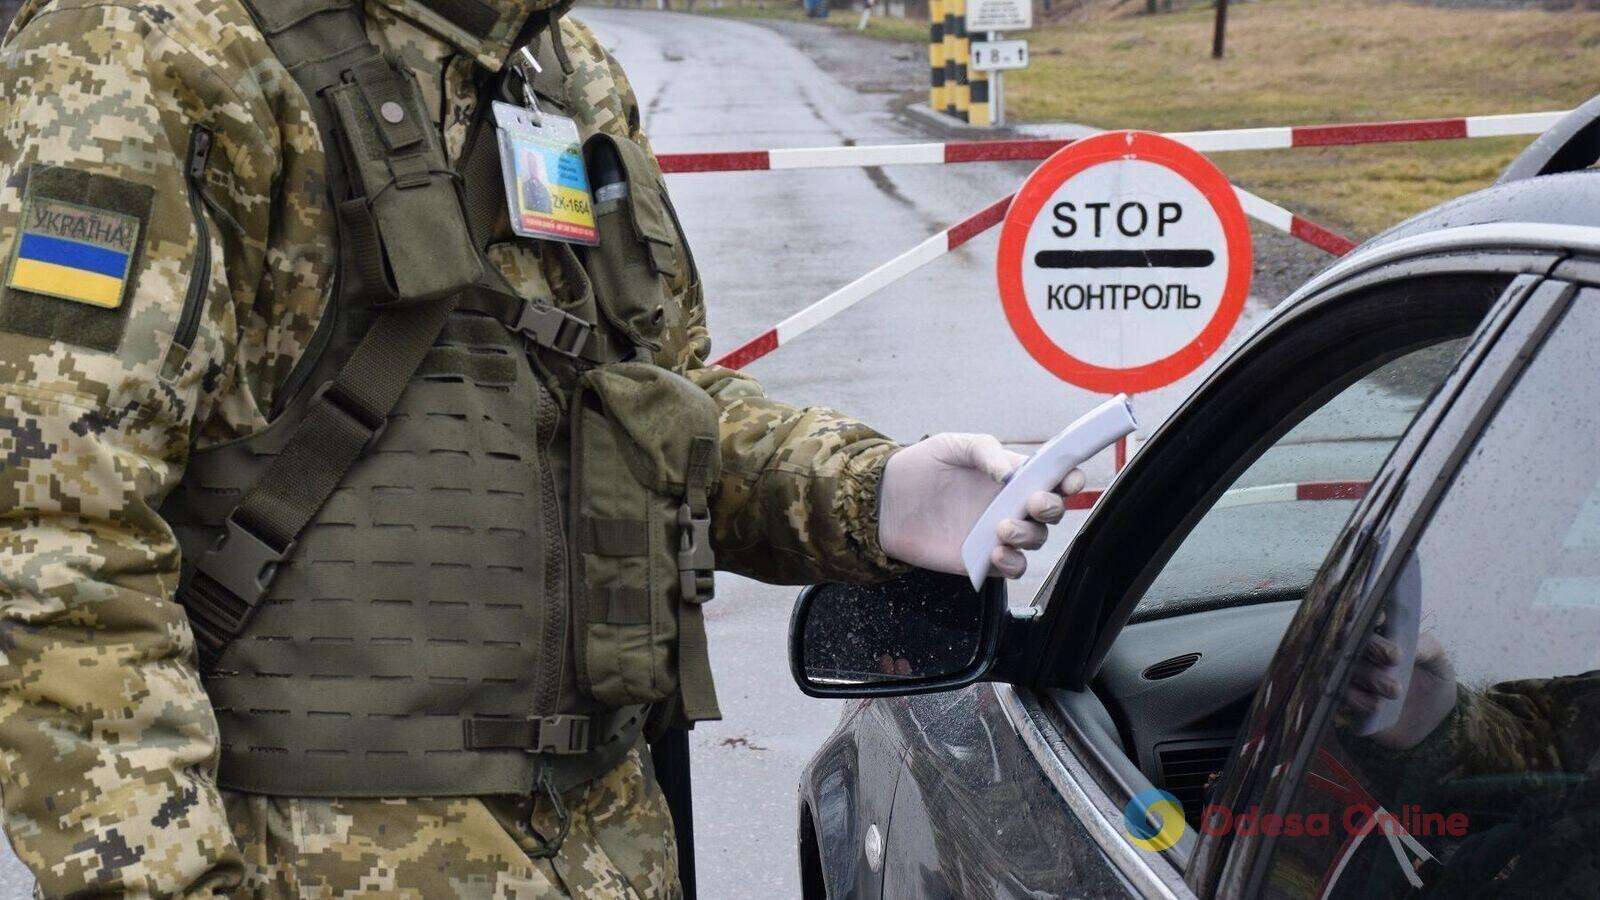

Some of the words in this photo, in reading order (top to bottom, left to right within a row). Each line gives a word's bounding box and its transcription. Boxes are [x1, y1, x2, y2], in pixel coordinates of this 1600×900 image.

[33, 205, 131, 246] УКРАЇНА
[1052, 201, 1183, 237] STOP
[1047, 284, 1201, 310] КОНТРОЛЬ
